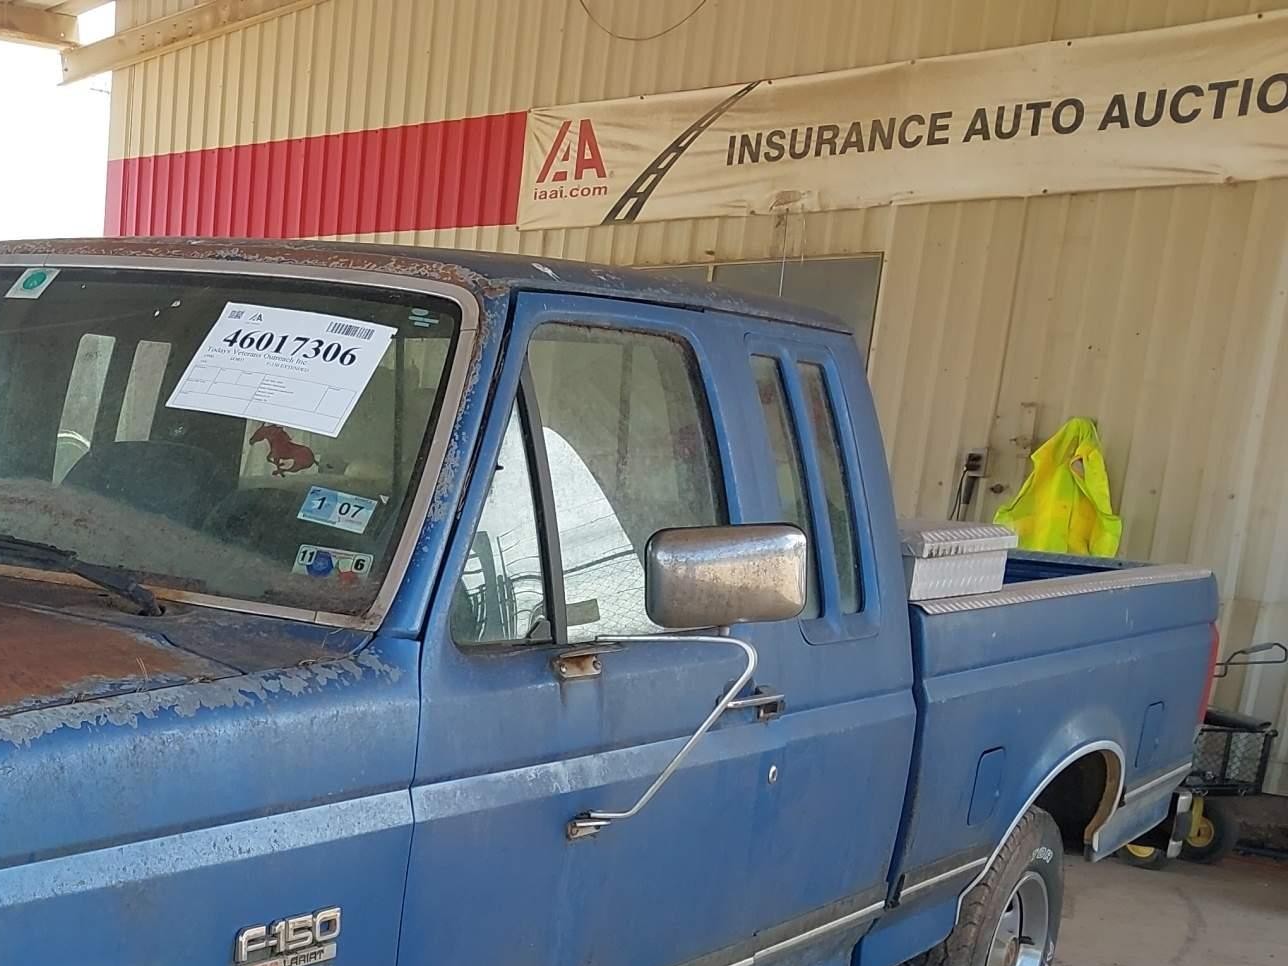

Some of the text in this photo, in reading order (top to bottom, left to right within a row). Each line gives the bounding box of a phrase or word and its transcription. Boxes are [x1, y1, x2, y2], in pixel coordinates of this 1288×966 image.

[726, 111, 953, 166] INSURANCE
[962, 98, 1085, 143] AUTO
[533, 184, 608, 200] iaai.com
[223, 328, 362, 367] 46017306
[338, 502, 365, 518] 07
[300, 549, 365, 571] 11 6
[236, 906, 341, 962] F-150
